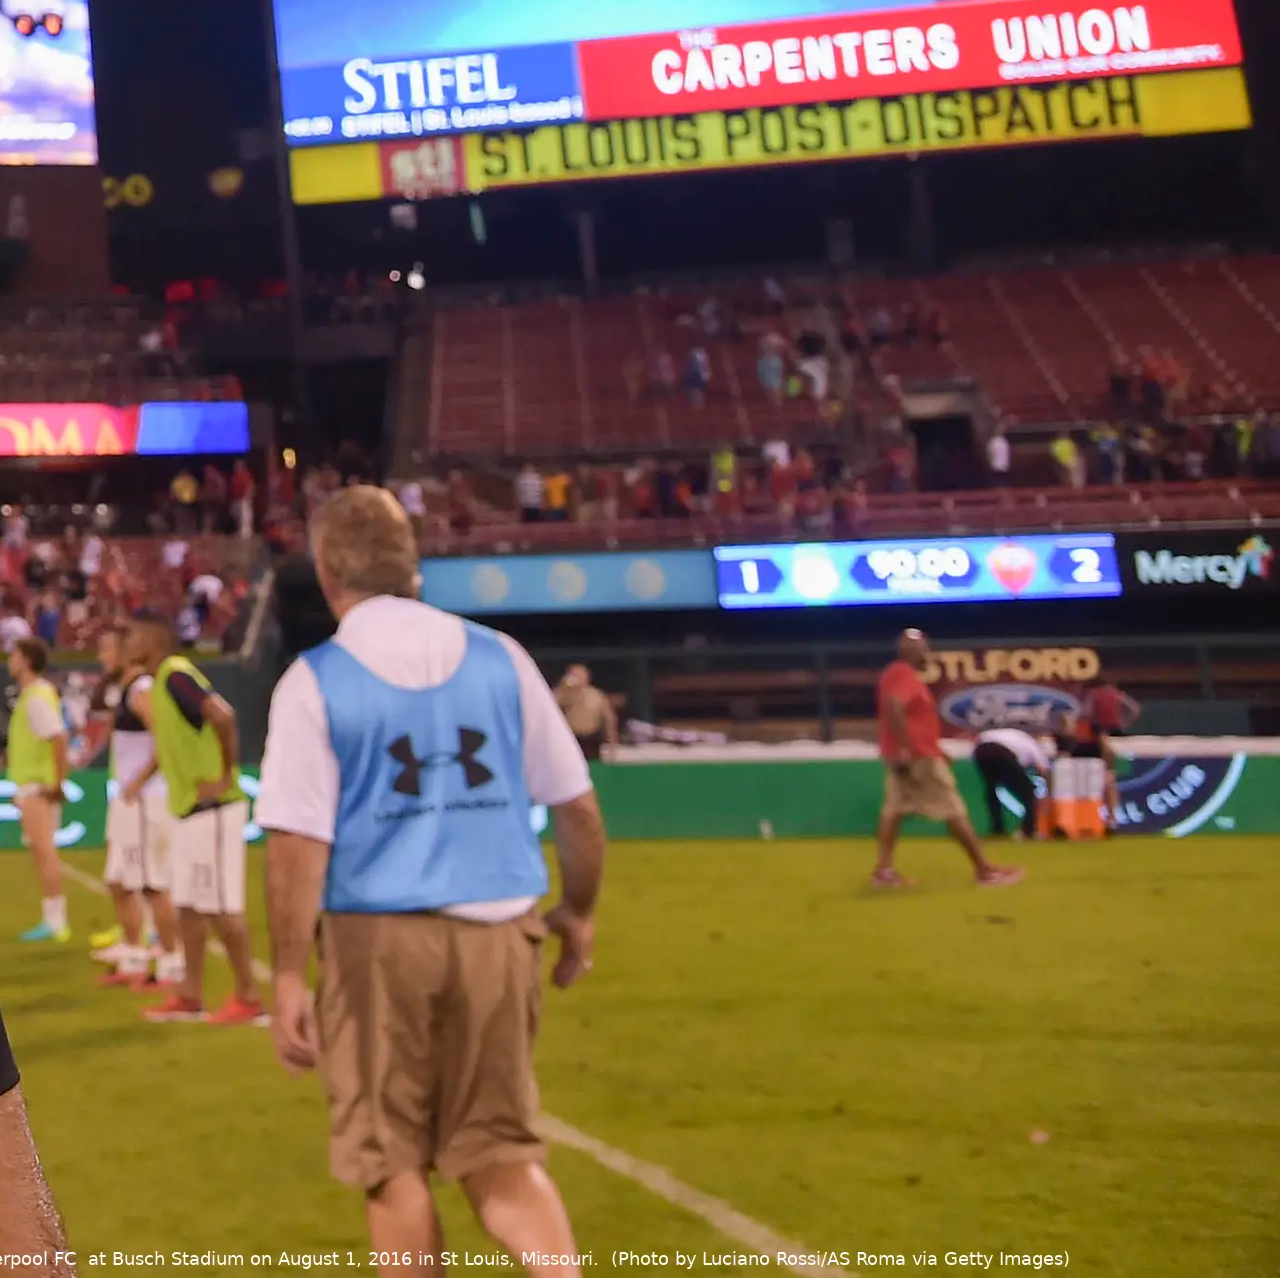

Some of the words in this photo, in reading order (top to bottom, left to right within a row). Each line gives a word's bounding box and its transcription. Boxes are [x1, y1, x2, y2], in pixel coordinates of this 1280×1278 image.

[651, 24, 960, 95] CARPENTERS
[990, 5, 1152, 63] UNION
[342, 53, 517, 114] STIFEL
[561, 117, 701, 171] LOUIS
[724, 76, 1140, 158] POST-DISPATCH
[741, 559, 760, 595] 1
[1069, 548, 1103, 583] 2
[1134, 549, 1246, 589] Mercy
[1146, 764, 1206, 815] CLUB
